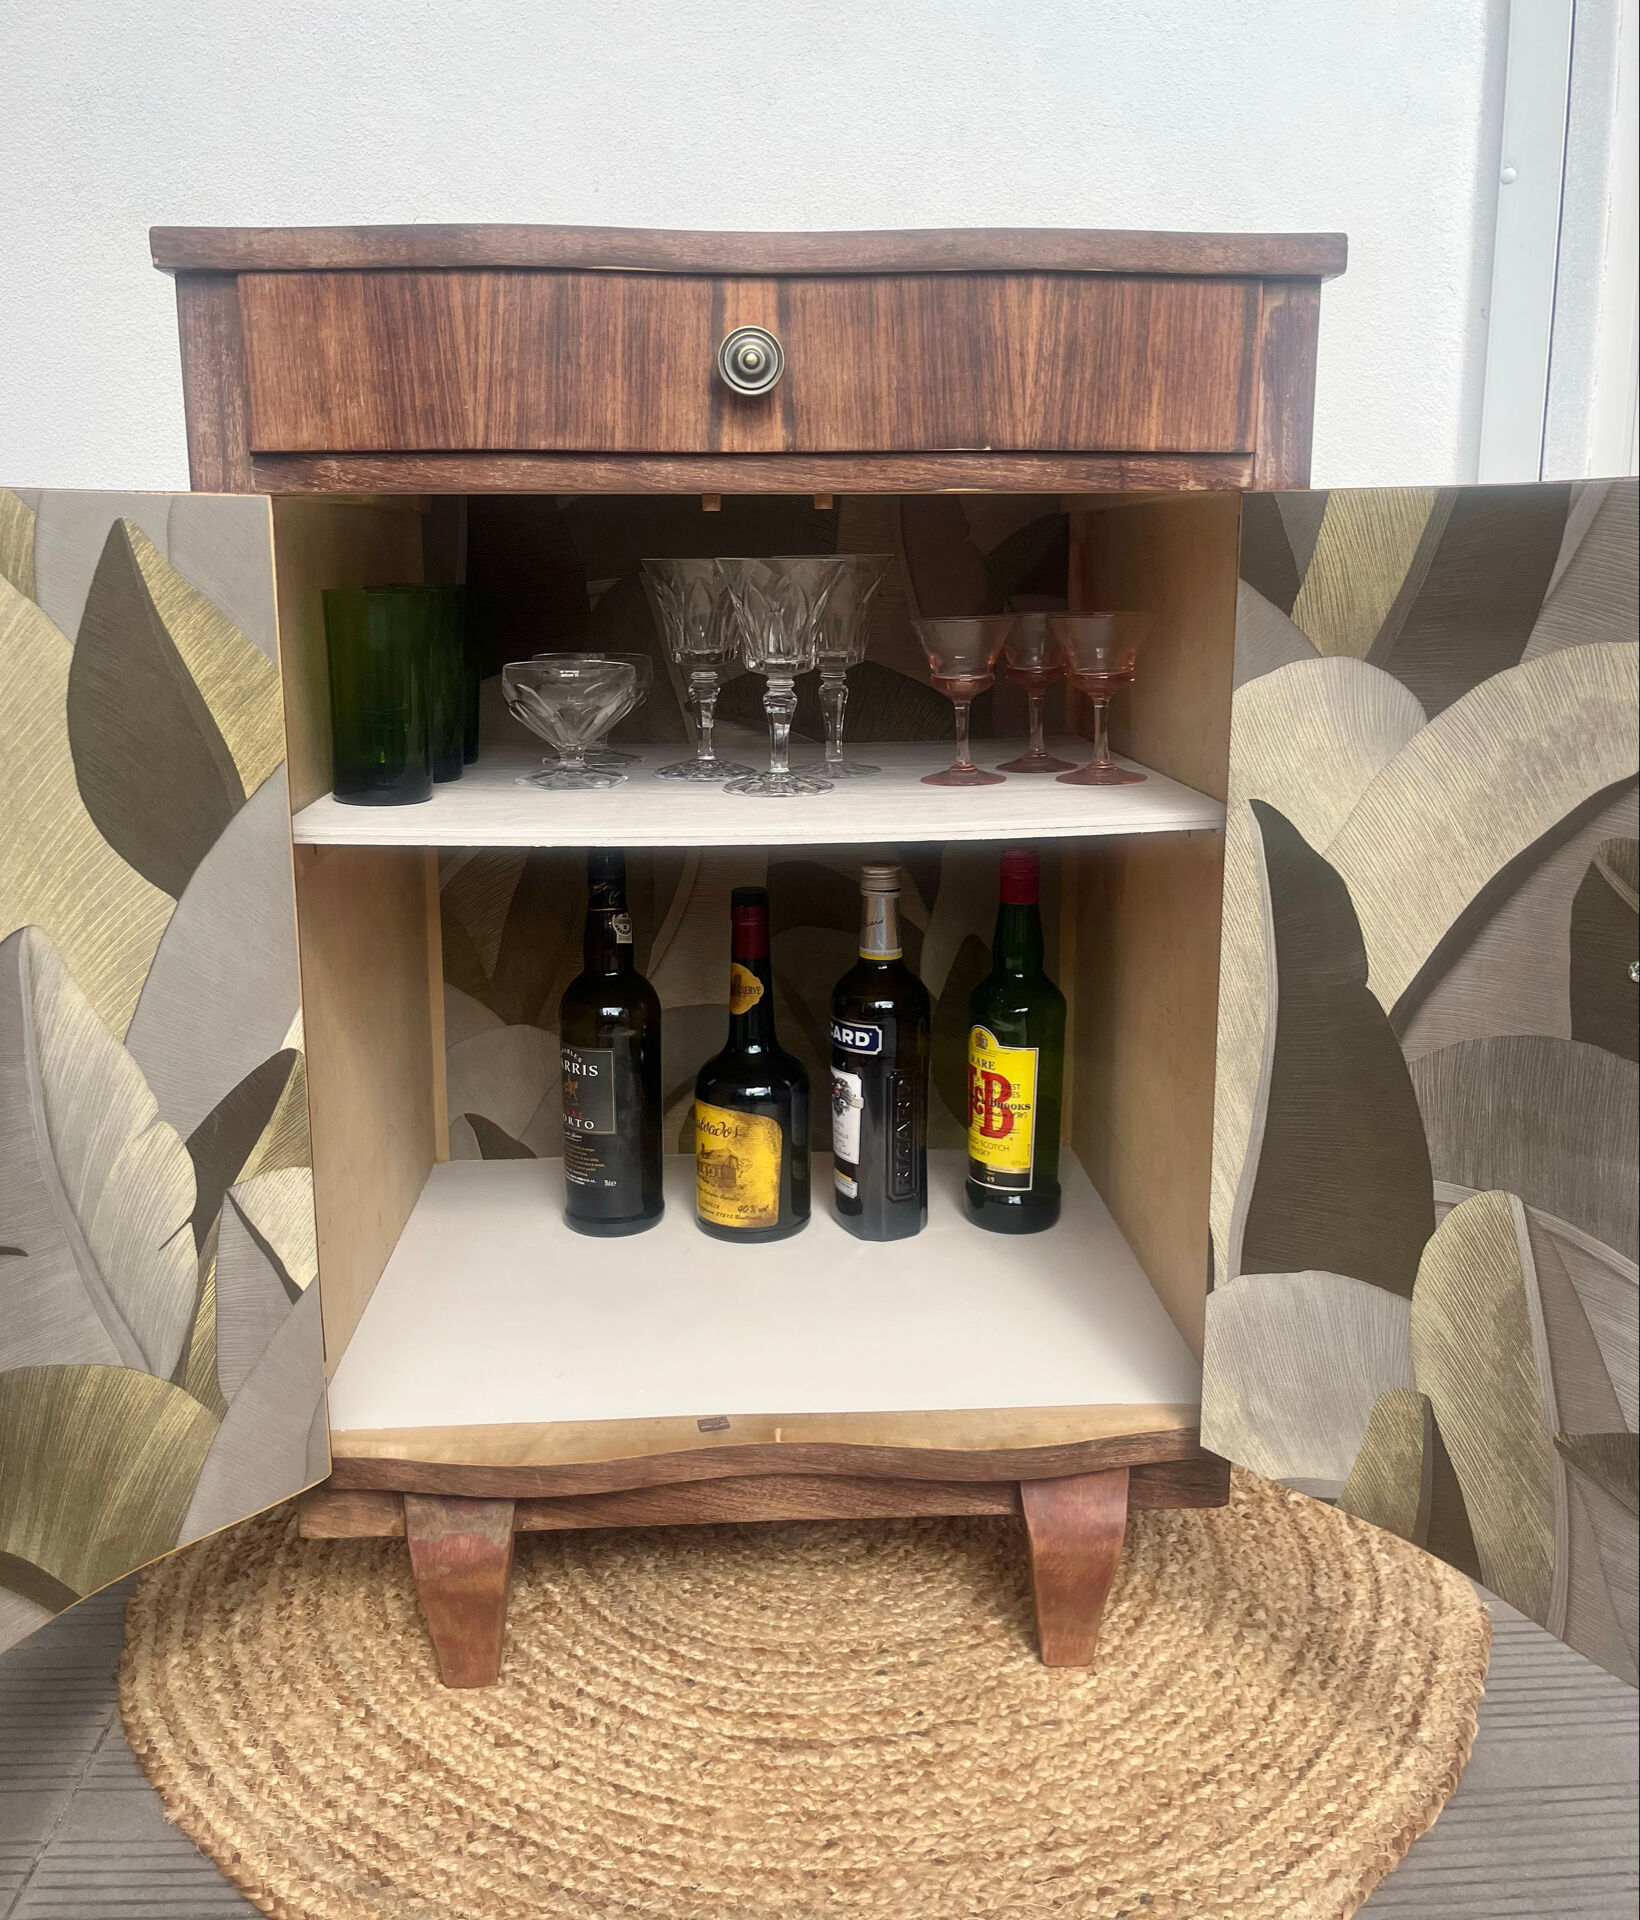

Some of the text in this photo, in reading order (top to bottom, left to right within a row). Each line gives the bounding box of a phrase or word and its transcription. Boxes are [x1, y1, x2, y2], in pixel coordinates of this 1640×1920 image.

[735, 985, 761, 995] SERVE
[562, 1112, 595, 1130] ORTO
[696, 1116, 744, 1138] alvados
[979, 1140, 1010, 1152] SCOTCH
